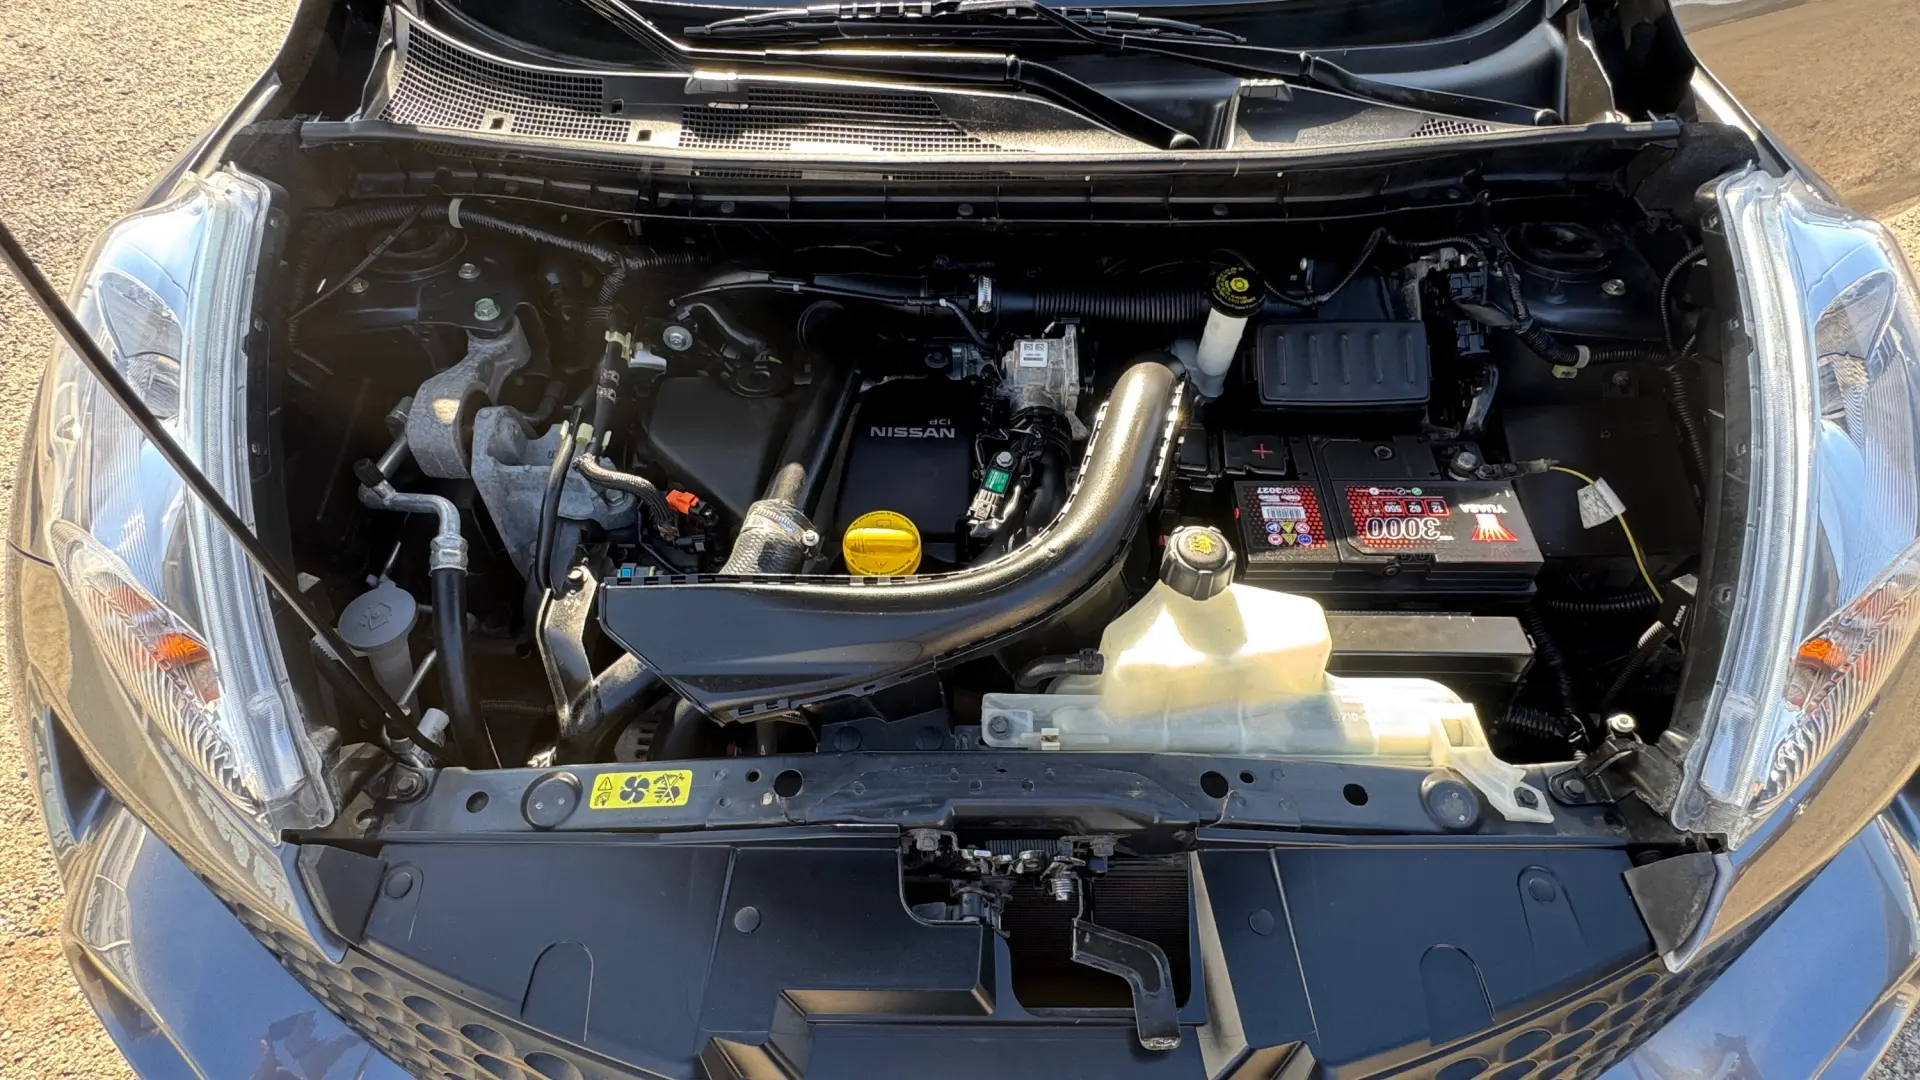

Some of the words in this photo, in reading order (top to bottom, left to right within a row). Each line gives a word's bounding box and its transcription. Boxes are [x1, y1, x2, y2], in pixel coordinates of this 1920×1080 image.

[870, 426, 955, 439] NISSAN
[1458, 503, 1508, 515] YUASA
[1366, 517, 1441, 540] 3000
